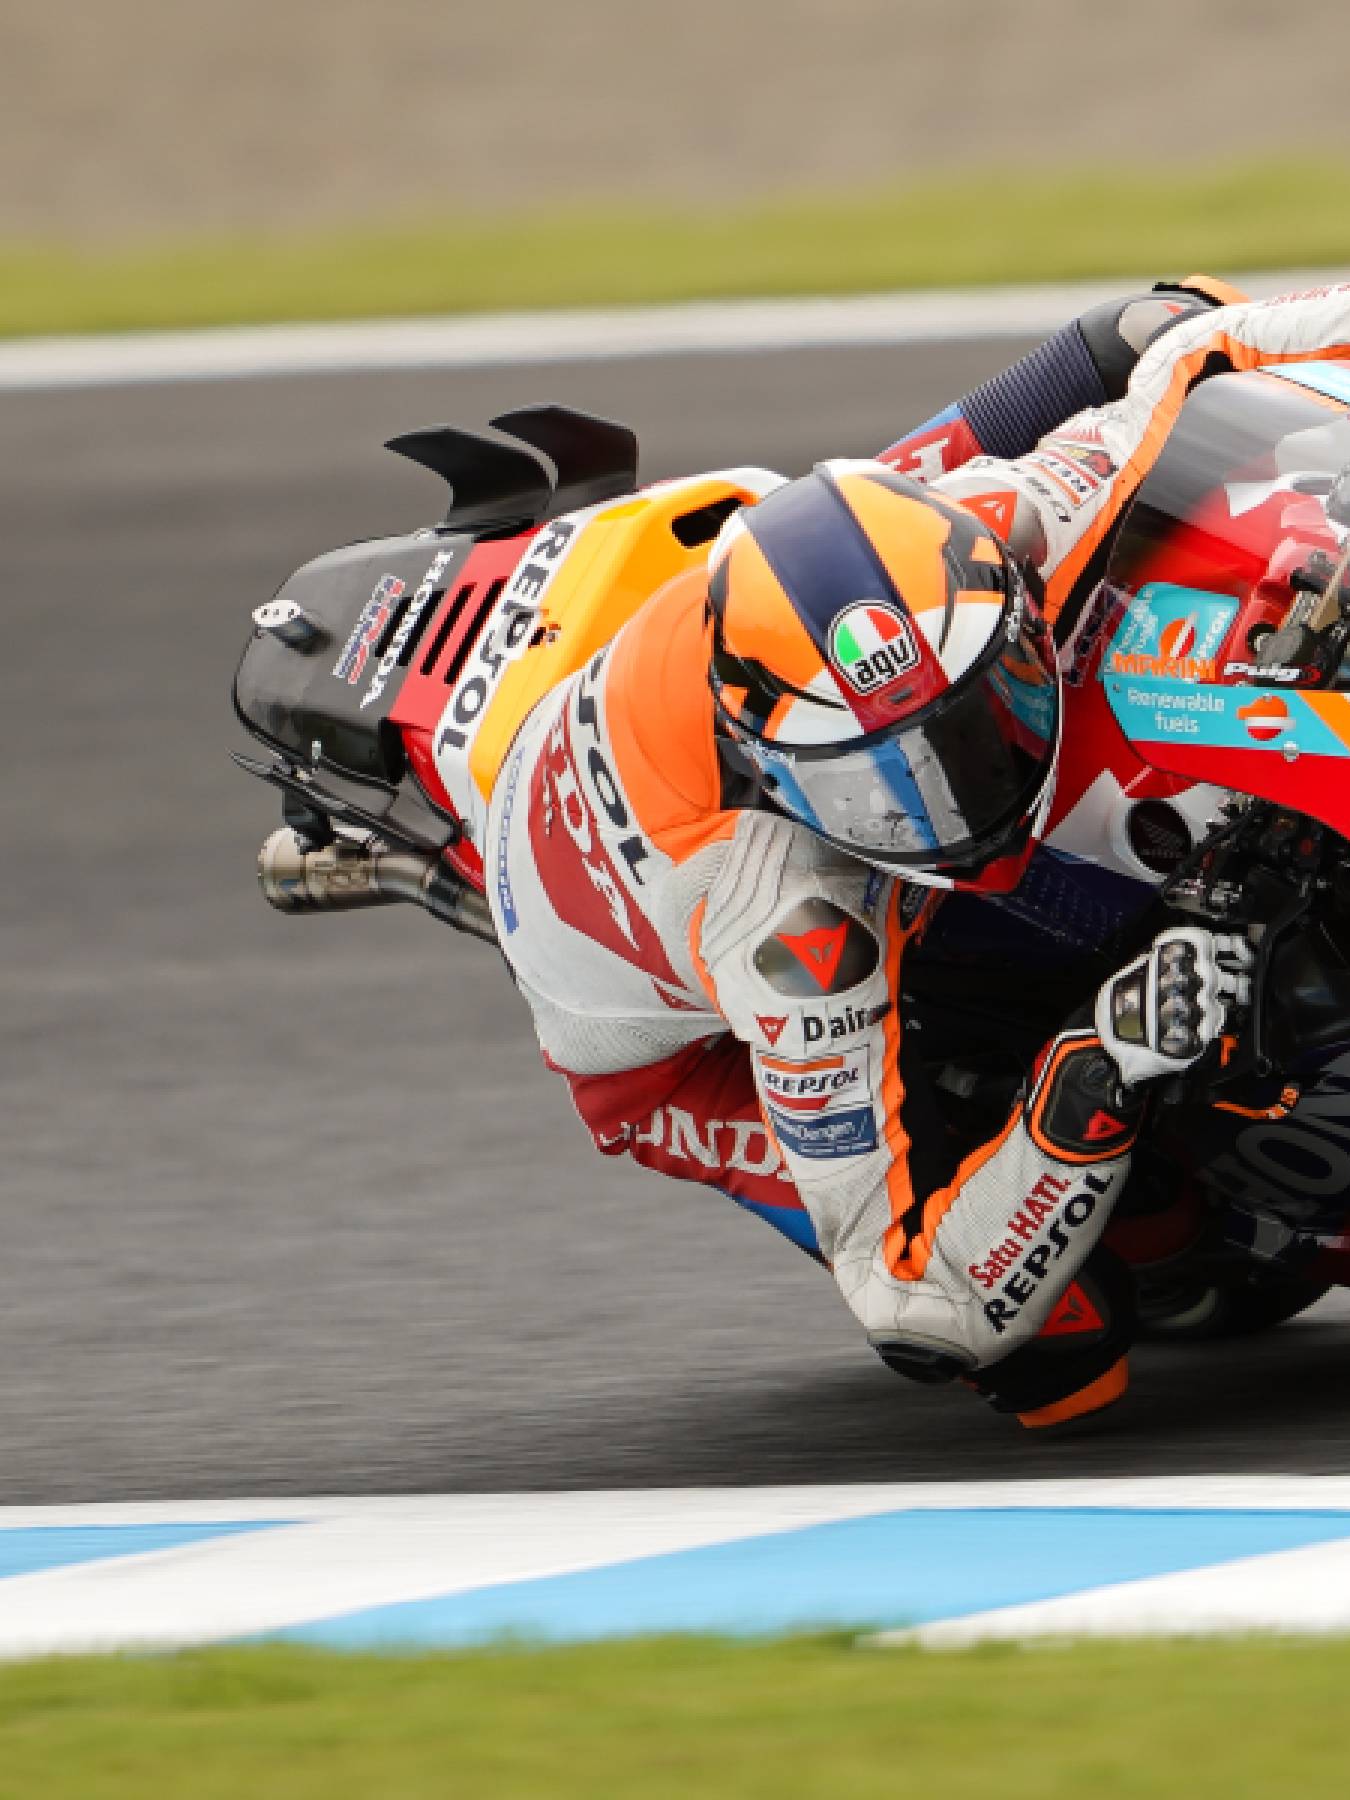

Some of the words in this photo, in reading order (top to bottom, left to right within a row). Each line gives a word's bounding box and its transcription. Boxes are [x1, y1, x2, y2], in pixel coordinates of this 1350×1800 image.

[360, 550, 454, 710] HONDA
[438, 521, 577, 757] REPSOL
[854, 638, 910, 685] agv
[1127, 687, 1225, 713] Renewable
[1154, 710, 1199, 734] fuels
[763, 1067, 859, 1095] REPSOL
[968, 1238, 1024, 1289] Satu
[983, 1172, 1114, 1335] REPSOL
